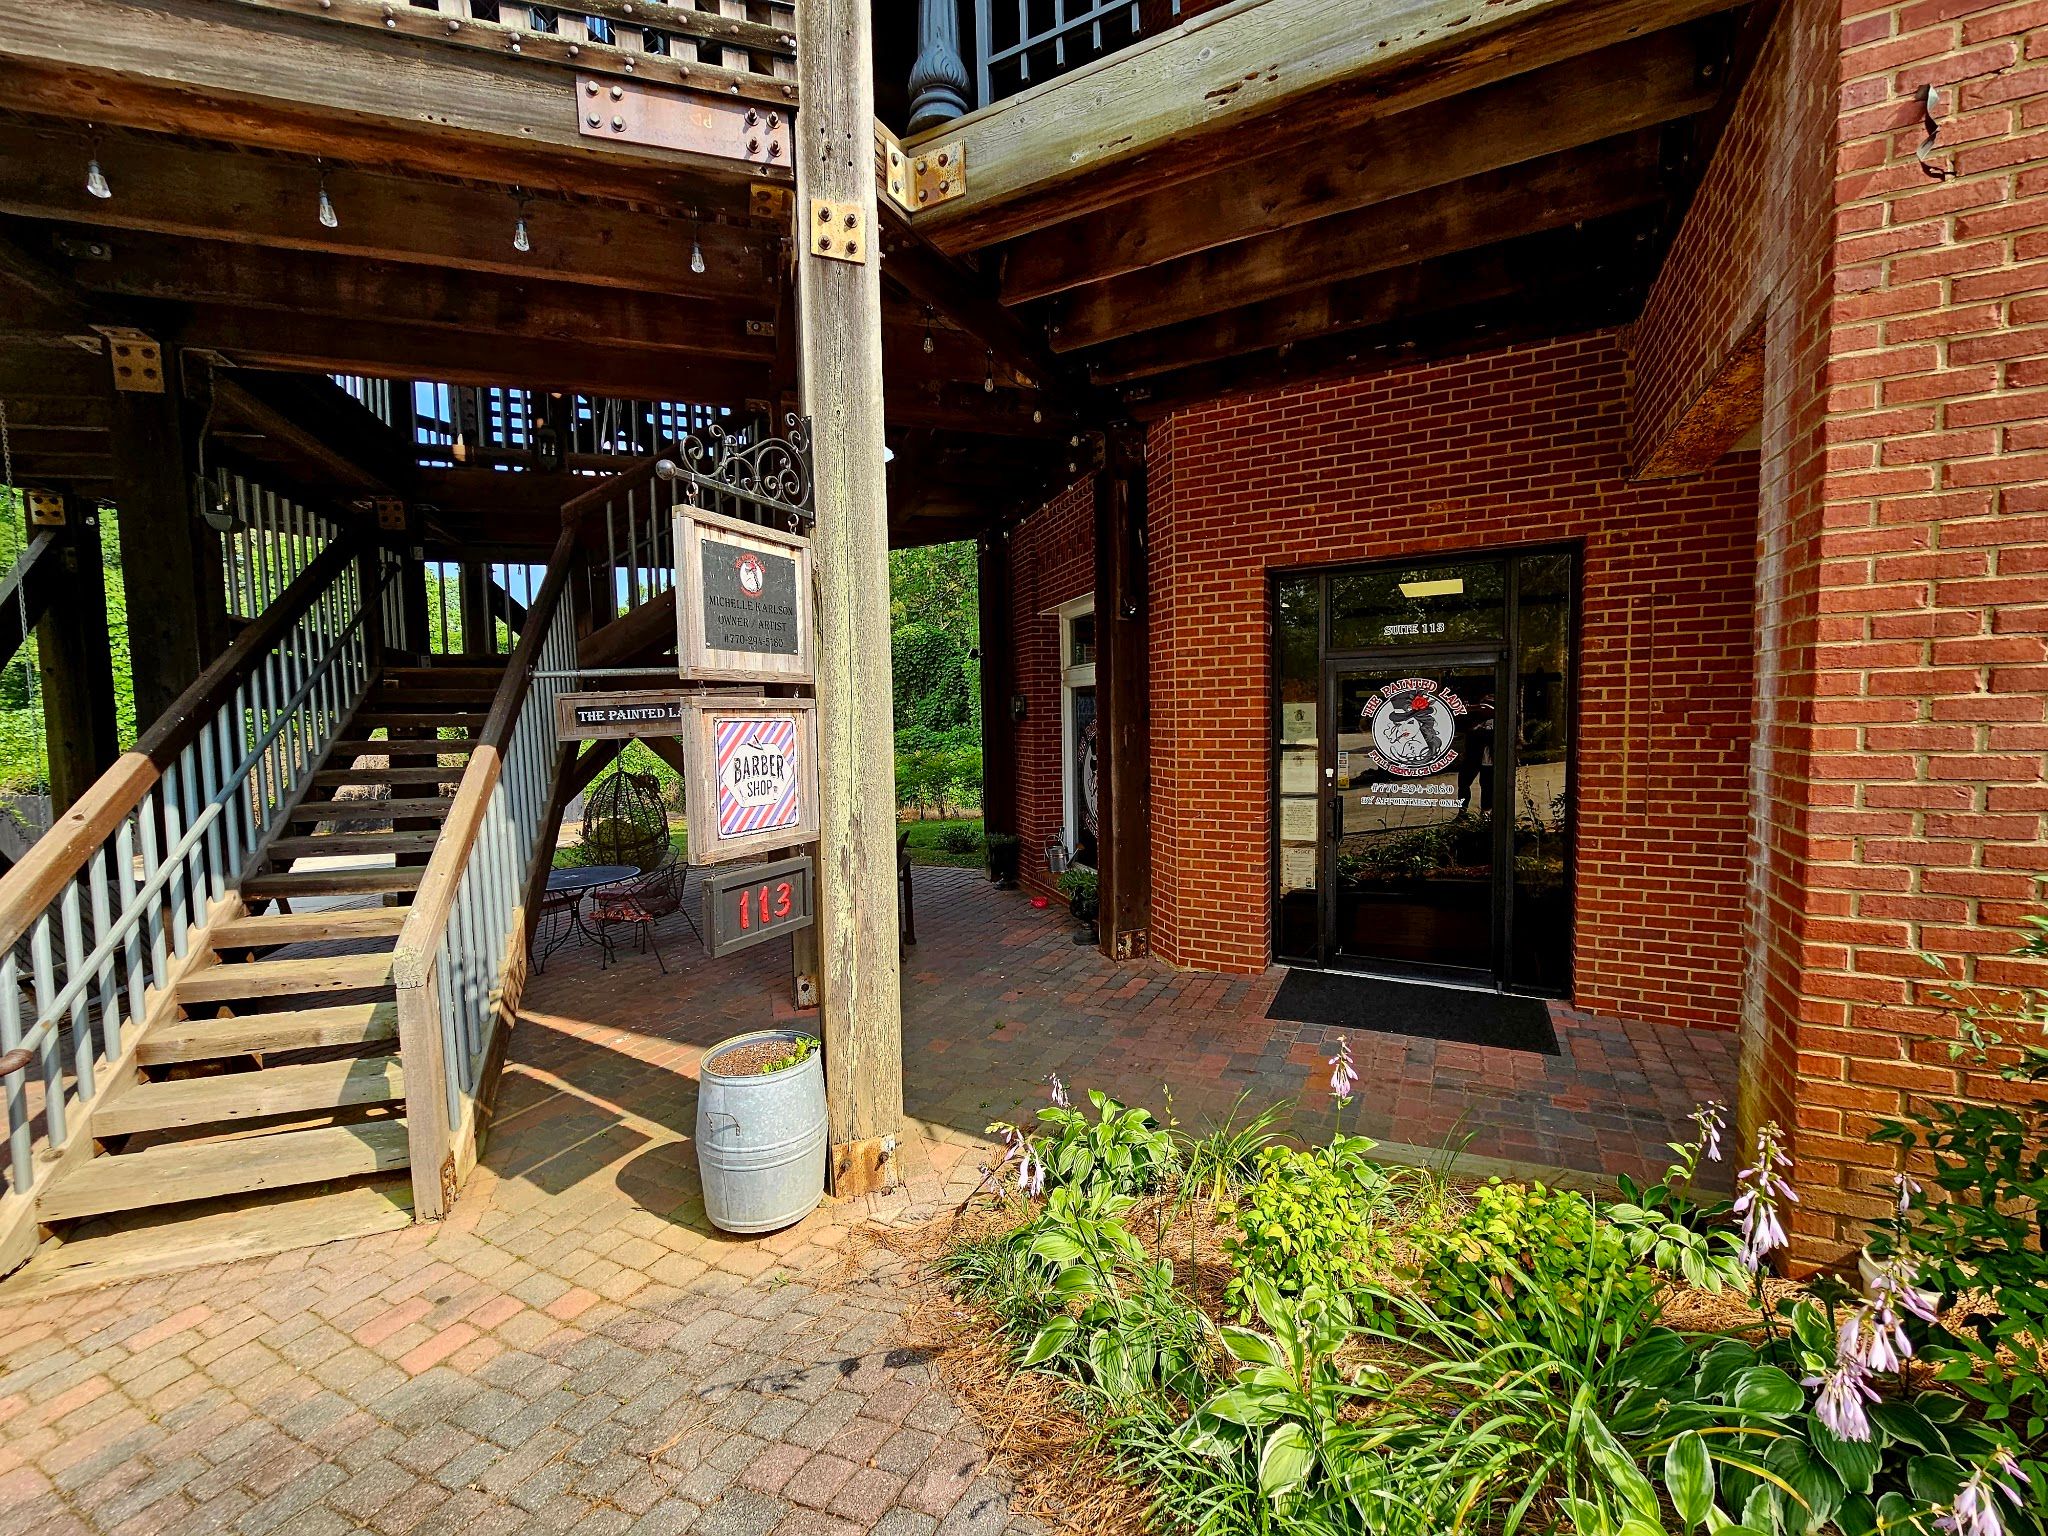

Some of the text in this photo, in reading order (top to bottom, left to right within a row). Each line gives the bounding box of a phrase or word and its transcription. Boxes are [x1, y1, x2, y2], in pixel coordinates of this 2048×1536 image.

[709, 595, 793, 616] MICHELLE KARLSON
[718, 614, 749, 628] OWNER
[758, 619, 787, 632] ARTIST
[1384, 622, 1445, 636] SUITE 113
[1361, 678, 1468, 717] THE PAINTED LADY
[578, 710, 606, 722] THE
[608, 708, 666, 721] PAINTED
[733, 754, 784, 785] BARBER
[1368, 749, 1459, 777] FULL SERVICE SALON
[747, 779, 773, 798] SHOP
[1370, 782, 1455, 795] #770-294-5180
[1360, 796, 1466, 808] BY APPOINTMENT ONLY
[739, 881, 792, 930] 113
